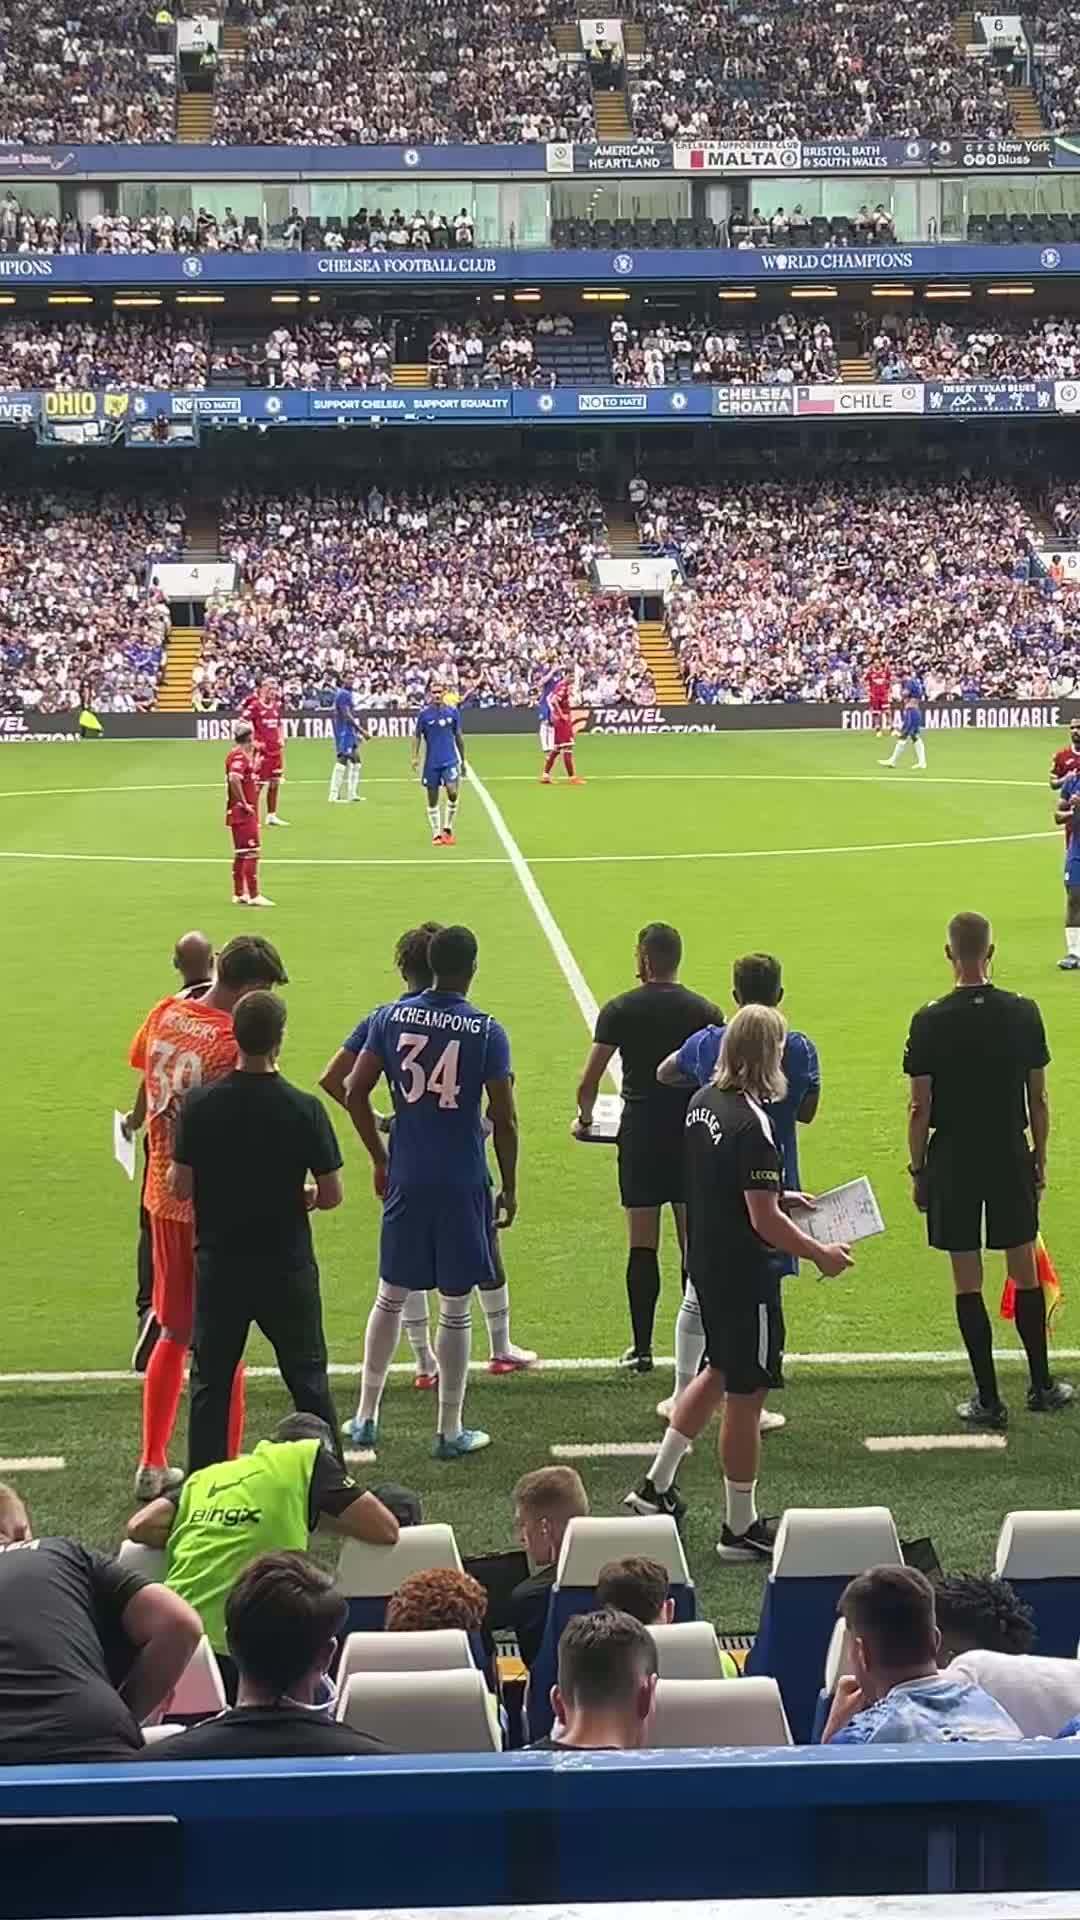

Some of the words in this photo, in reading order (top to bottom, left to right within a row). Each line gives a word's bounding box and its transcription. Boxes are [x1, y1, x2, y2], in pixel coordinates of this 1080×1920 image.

[595, 22, 605, 35] 5
[994, 19, 1004, 31] 6
[594, 145, 655, 156] AMERICAN
[852, 145, 880, 156] BATH
[997, 141, 1022, 153] New
[589, 158, 660, 169] HEARTLAND
[708, 152, 777, 166] MALTA
[813, 157, 850, 167] SOUTH
[852, 156, 888, 167] WALES
[318, 258, 380, 273] CHELSEA
[384, 258, 456, 273] FOOTBALL
[459, 258, 496, 272] CLUB
[820, 252, 913, 269] CHAMPIONS
[719, 387, 792, 401] CHELSEA
[840, 393, 893, 409] CHILE
[45, 392, 96, 416] OHIO
[313, 399, 360, 409] SUPPORT
[361, 399, 406, 409] CHELSEA
[413, 399, 460, 408] SUPPORT
[461, 399, 509, 408] EQUALITY
[580, 396, 601, 408] NO
[604, 398, 618, 406] TO
[619, 398, 642, 406] HATE
[719, 400, 789, 414] CROATIA
[631, 562, 640, 575] 5
[1068, 555, 1077, 569] 6
[593, 708, 666, 723] TRAVEL
[925, 708, 972, 729] MADE
[976, 707, 1060, 728] BOOKABLE
[390, 1006, 482, 1034] ACHEAMPONG
[396, 1031, 461, 1109] 34
[685, 1107, 723, 1145] CHELSEA
